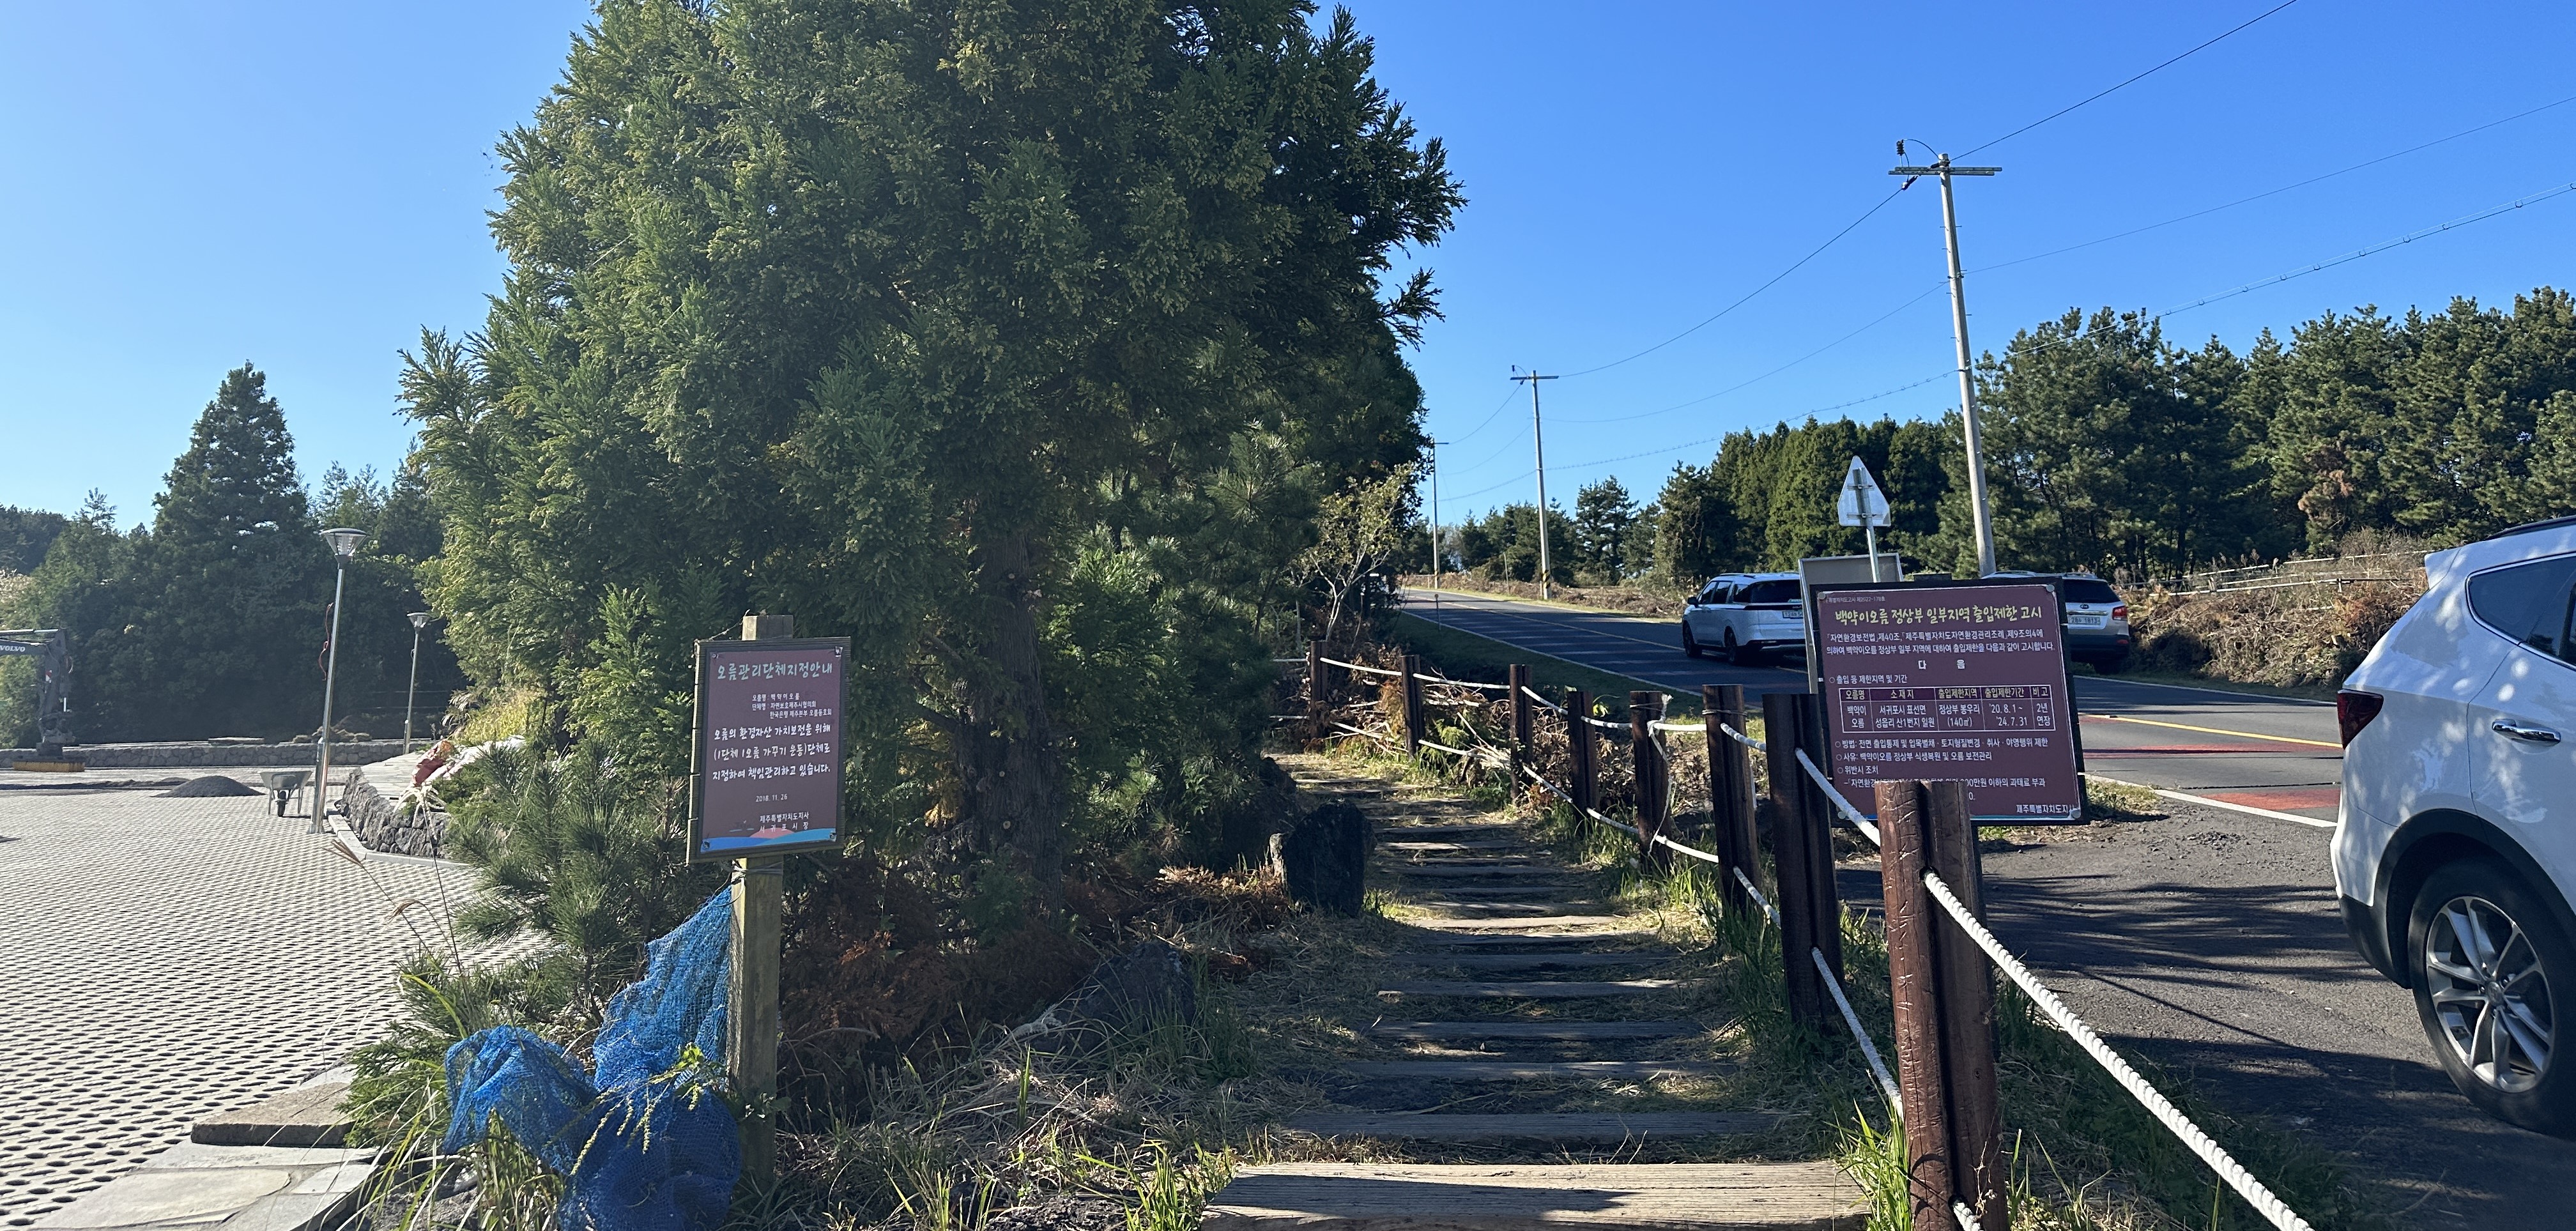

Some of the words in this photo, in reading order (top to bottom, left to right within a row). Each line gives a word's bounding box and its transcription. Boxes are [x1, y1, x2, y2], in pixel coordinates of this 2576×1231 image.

[1836, 608, 1889, 625] 백약이오름
[1891, 608, 1923, 624] 정상부
[1927, 607, 1970, 623] 일부지역
[1973, 605, 2018, 623] 출입제한
[2021, 606, 2042, 618] 고시
[1827, 646, 1845, 655] 의하여
[1846, 645, 1876, 655] 백약이오름
[1878, 645, 1896, 654] 정상부
[1898, 645, 1911, 654] 일부
[1913, 645, 1931, 654] 지역에
[1933, 644, 1951, 653] 대하여
[1953, 643, 1984, 653] 출입제한을
[1986, 643, 2005, 652] 다음과
[2021, 641, 2055, 652] 고시합니다.
[1836, 675, 1849, 684] 출입
[1851, 675, 1857, 684] 등
[1859, 675, 1885, 684] 제한지역
[1886, 675, 1892, 684] 및
[1894, 675, 1907, 684] 기간
[1846, 690, 1864, 700] 오름명
[1938, 688, 1977, 699] 출입제한지역
[1985, 687, 2024, 698] 출입제한기간
[1847, 705, 1867, 715] 백약이
[1880, 705, 1905, 715] 서귀포시
[1906, 705, 1926, 715] 표선면
[1939, 704, 1959, 714] 정상부
[1960, 704, 1980, 714] 봉우리
[2037, 703, 2048, 713] 2년
[770, 710, 788, 719] 한국은행
[1851, 718, 1864, 728] 오름
[1876, 718, 1894, 728] 성읍리
[1896, 717, 1919, 728] 산1번지
[1922, 717, 1935, 728] 일원
[2037, 717, 2051, 726] 연장
[714, 728, 736, 741] 오름의
[740, 726, 772, 740] 환경자산
[774, 723, 812, 736] 가치보전을
[815, 723, 831, 733] 위해
[1843, 740, 1857, 749] 방법:
[1859, 740, 1872, 749] 전면
[1873, 738, 1899, 749] 출입통제
[1901, 739, 1908, 748] 및
[1909, 738, 1935, 748] 입목벌채
[1941, 738, 1981, 747] 토지형질변경
[1987, 737, 2000, 747] 취사
[2006, 737, 2033, 747] 야영행위
[2034, 737, 2048, 747] 제한
[714, 747, 738, 761] (1단체
[742, 746, 760, 759] 1오름
[763, 745, 786, 758] 가꾸기
[789, 742, 831, 757] 운동)단체로
[1844, 753, 1858, 761] 사유:
[1860, 753, 1892, 761] 백약이오름
[1894, 753, 1913, 761] 정상부
[1915, 752, 1941, 761] 식생복원
[1942, 752, 1949, 760] 및
[1951, 751, 1964, 761] 오름
[1966, 751, 1992, 760] 보전관리
[712, 769, 745, 782] 지정하여
[748, 765, 796, 779] 책임관리하고
[799, 763, 831, 777] 있습니다.
[1844, 765, 1864, 774] 위반시
[1866, 765, 1878, 774] 조치
[1988, 778, 2009, 787] 이하의
[2010, 778, 2030, 787] 과태료
[2032, 778, 2046, 787] 부과
[760, 811, 809, 823] 제주특별자치도지사
